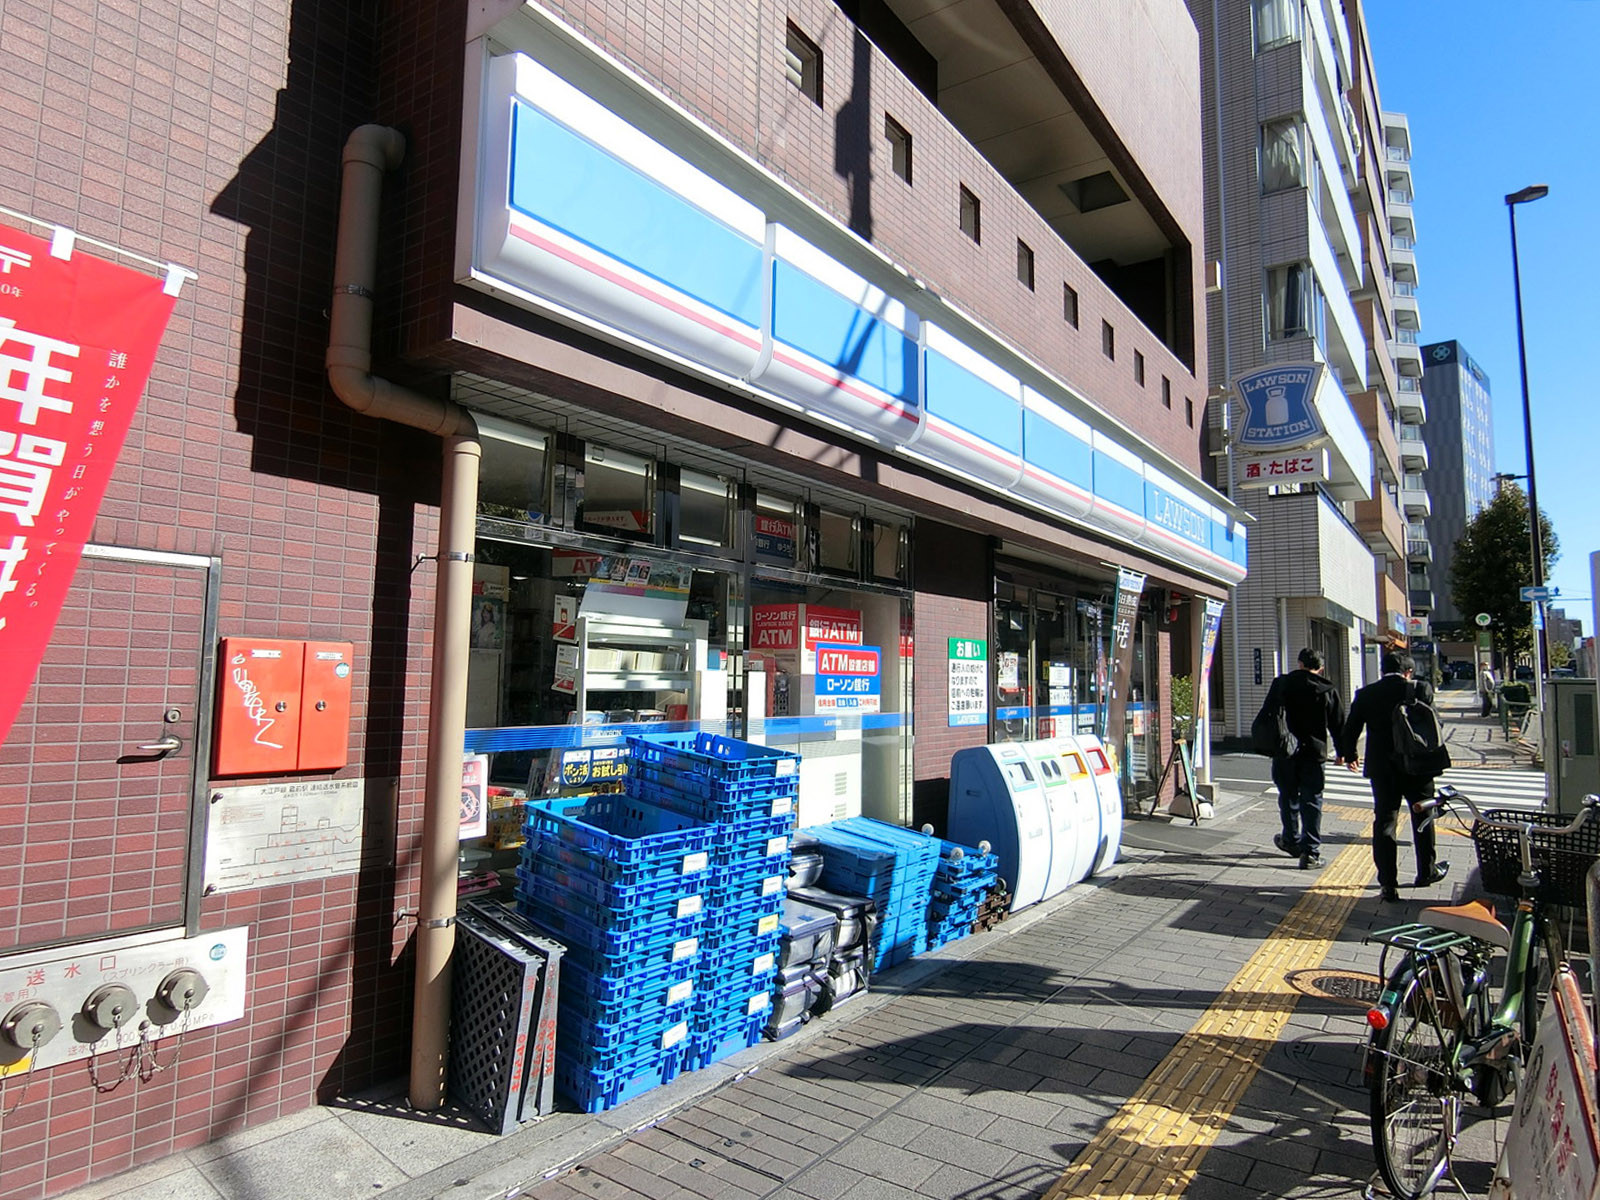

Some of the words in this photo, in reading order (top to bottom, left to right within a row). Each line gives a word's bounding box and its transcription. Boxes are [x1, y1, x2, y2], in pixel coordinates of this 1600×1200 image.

[1244, 373, 1308, 393] LAWSON
[1247, 419, 1311, 438] STATION
[25, 349, 128, 607] 誰かを想う日がやってくる。
[1153, 490, 1205, 544] LAWSON
[755, 611, 797, 621] ローソン銀行
[757, 629, 793, 645] ATM
[809, 619, 858, 641] 銀行ATM
[956, 641, 981, 658] お願い
[827, 678, 870, 692] ローソン銀行
